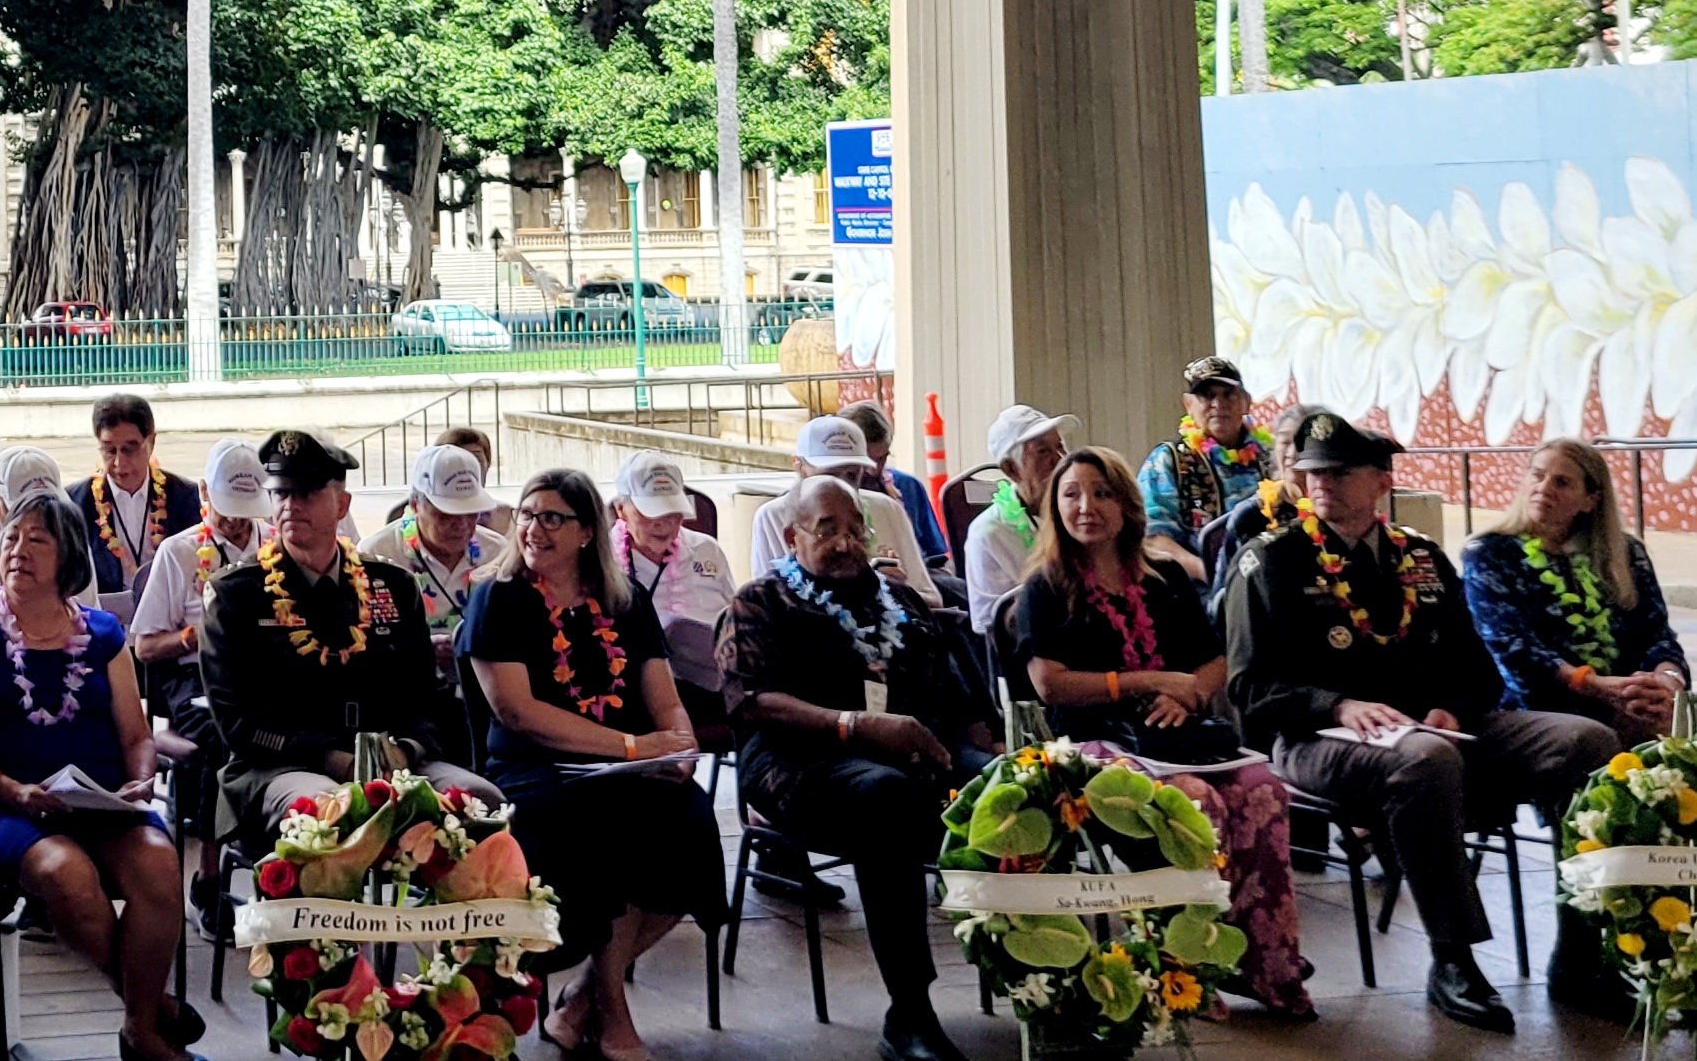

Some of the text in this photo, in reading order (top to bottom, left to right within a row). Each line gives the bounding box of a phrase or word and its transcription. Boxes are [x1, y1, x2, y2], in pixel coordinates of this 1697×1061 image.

[1648, 852, 1687, 864] Korea
[292, 907, 505, 934] Freedom is not free
